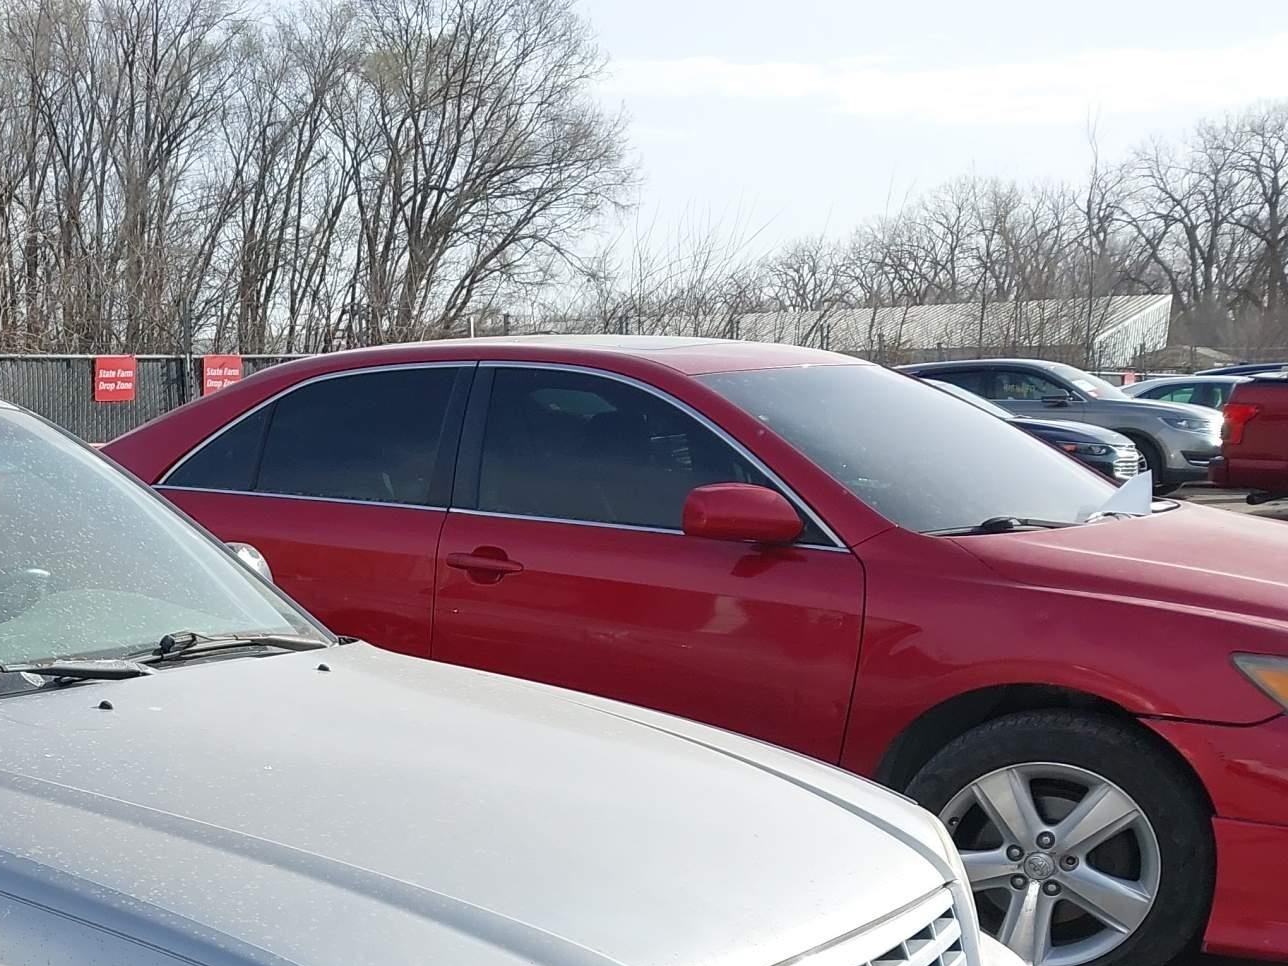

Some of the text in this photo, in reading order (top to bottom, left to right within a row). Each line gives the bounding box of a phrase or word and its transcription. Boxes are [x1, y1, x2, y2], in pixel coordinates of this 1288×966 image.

[99, 368, 133, 378] State Farm
[207, 367, 239, 376] State Farm
[99, 380, 133, 391] Drop Zone
[207, 379, 222, 390] Drop
